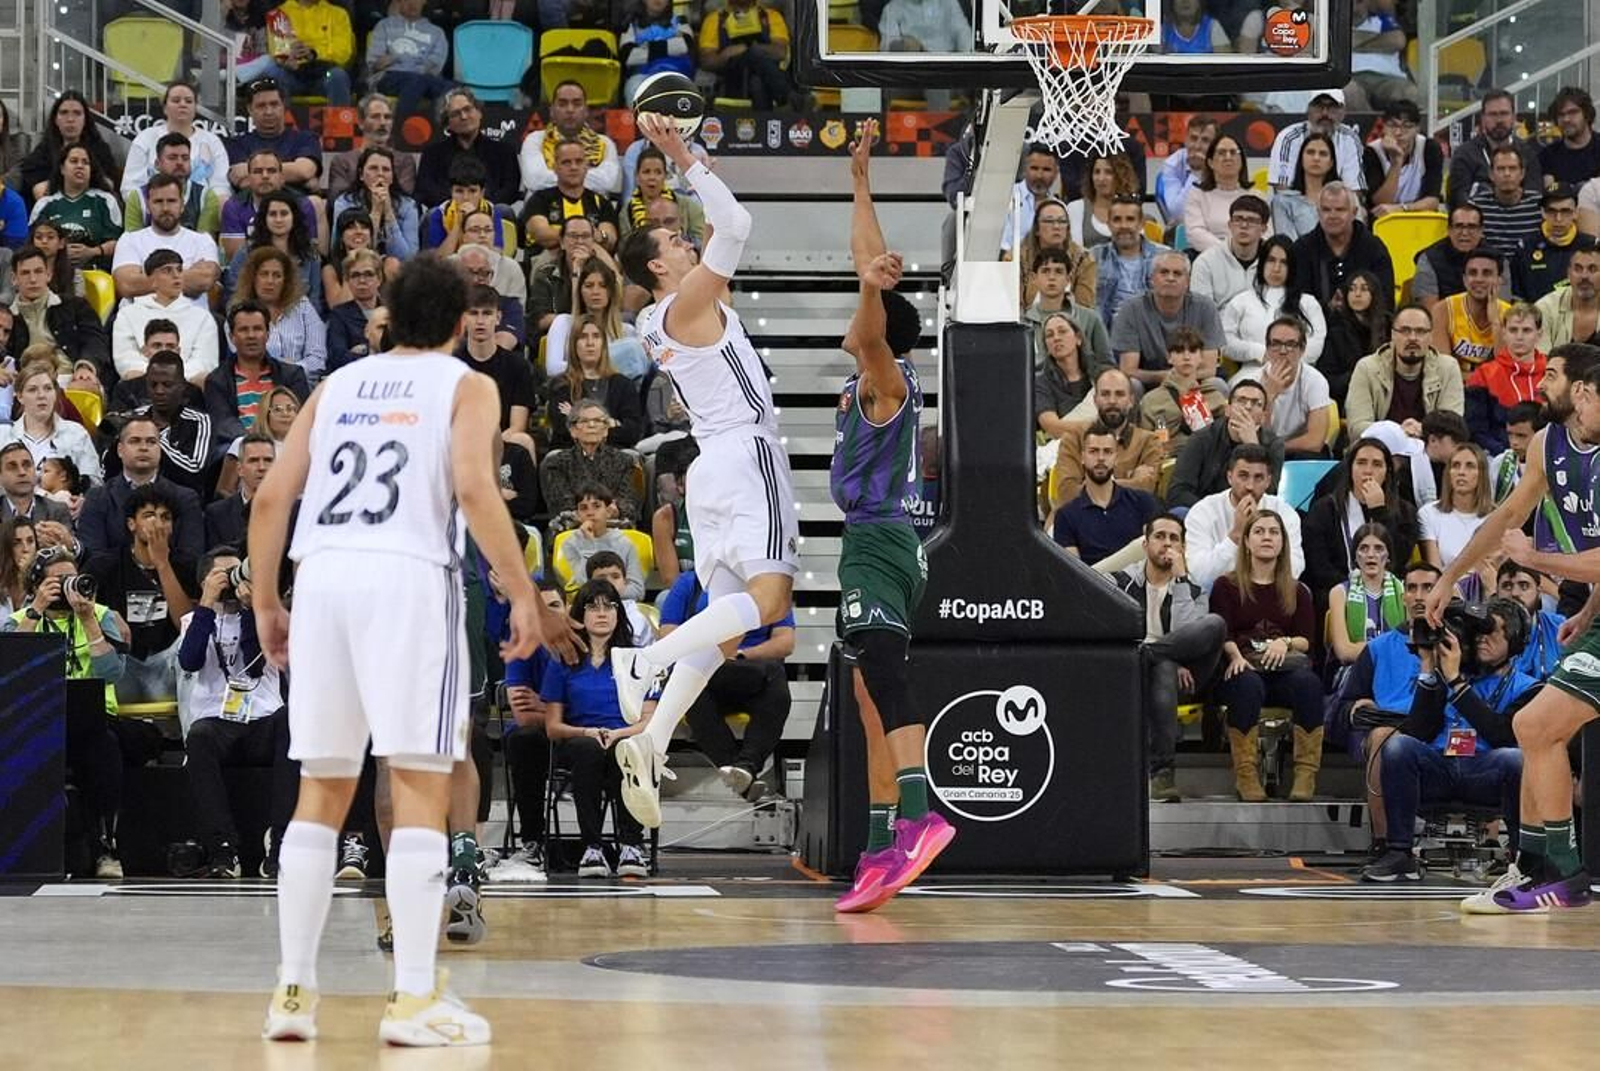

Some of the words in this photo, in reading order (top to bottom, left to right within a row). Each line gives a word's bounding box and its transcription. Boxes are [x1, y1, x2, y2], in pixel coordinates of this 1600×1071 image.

[789, 130, 812, 139] BAXI
[356, 380, 414, 400] LLULL
[317, 440, 409, 526] 23
[939, 598, 1045, 624] #CopaACB
[961, 729, 994, 742] acb
[948, 742, 1010, 764] Copa
[951, 764, 975, 776] del
[978, 765, 1019, 787] Rey
[943, 789, 967, 799] Gran
[968, 789, 1008, 799] Canaria
